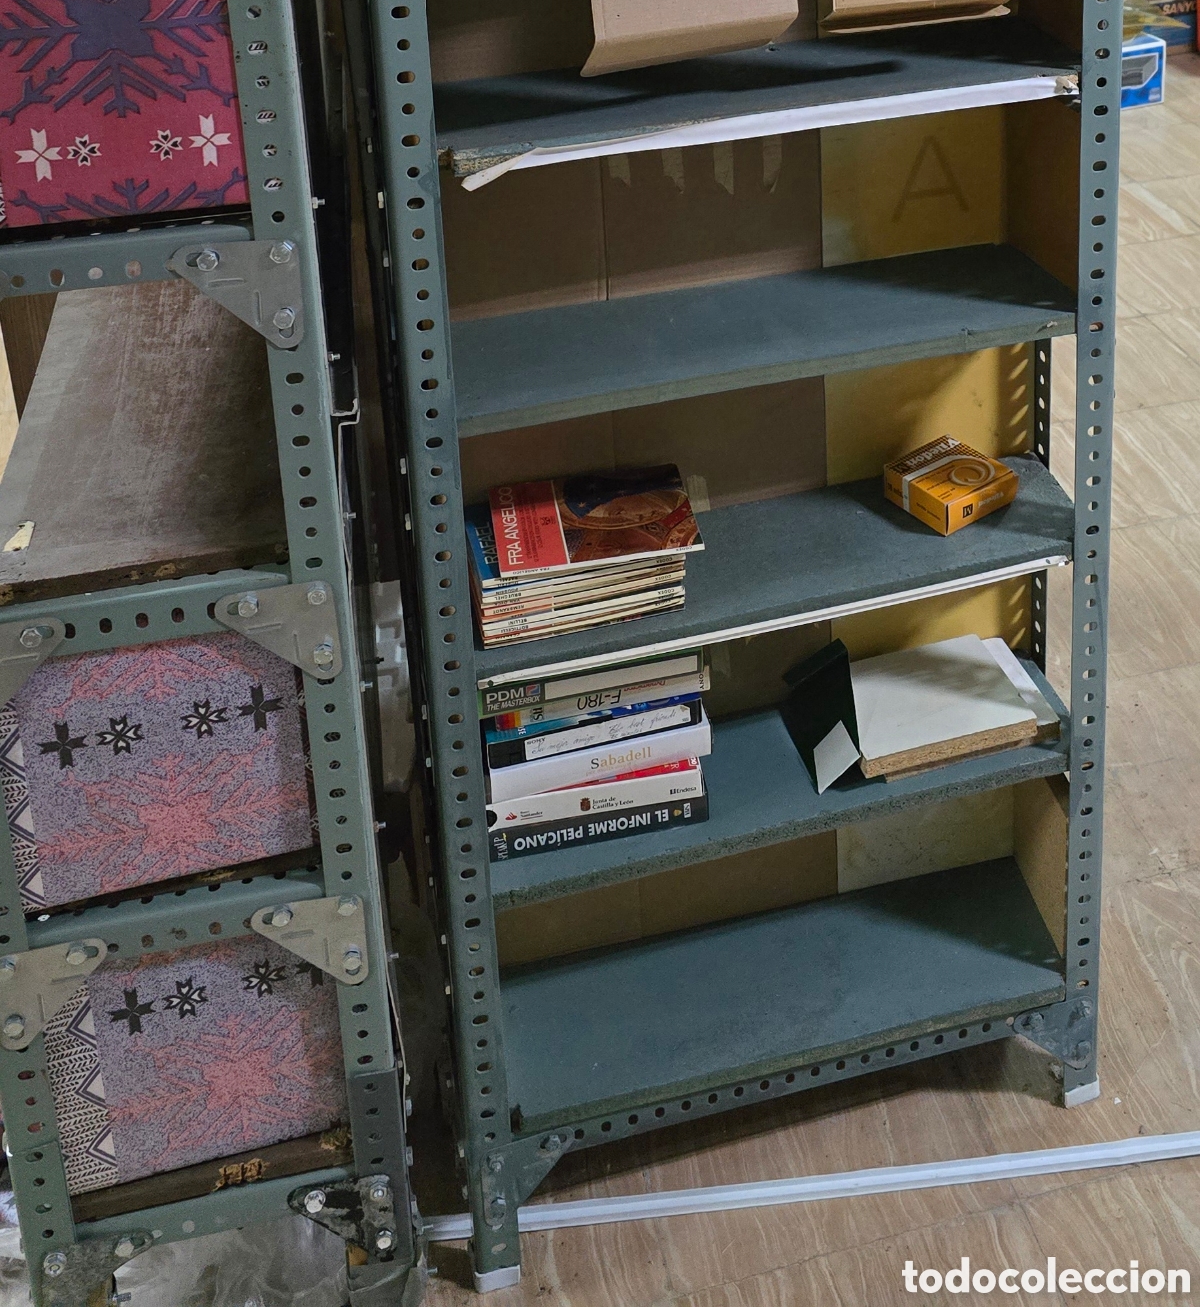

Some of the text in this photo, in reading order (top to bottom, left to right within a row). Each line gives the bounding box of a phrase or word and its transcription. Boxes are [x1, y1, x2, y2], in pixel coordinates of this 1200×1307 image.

[500, 486, 524, 566] FRA ANGELICO
[486, 686, 525, 705] PDM
[486, 695, 541, 712] THE MASTERBOX
[590, 746, 652, 771] Sabadell
[676, 786, 697, 794] Endesa
[513, 808, 670, 852] EL INFORME PELÍCANO
